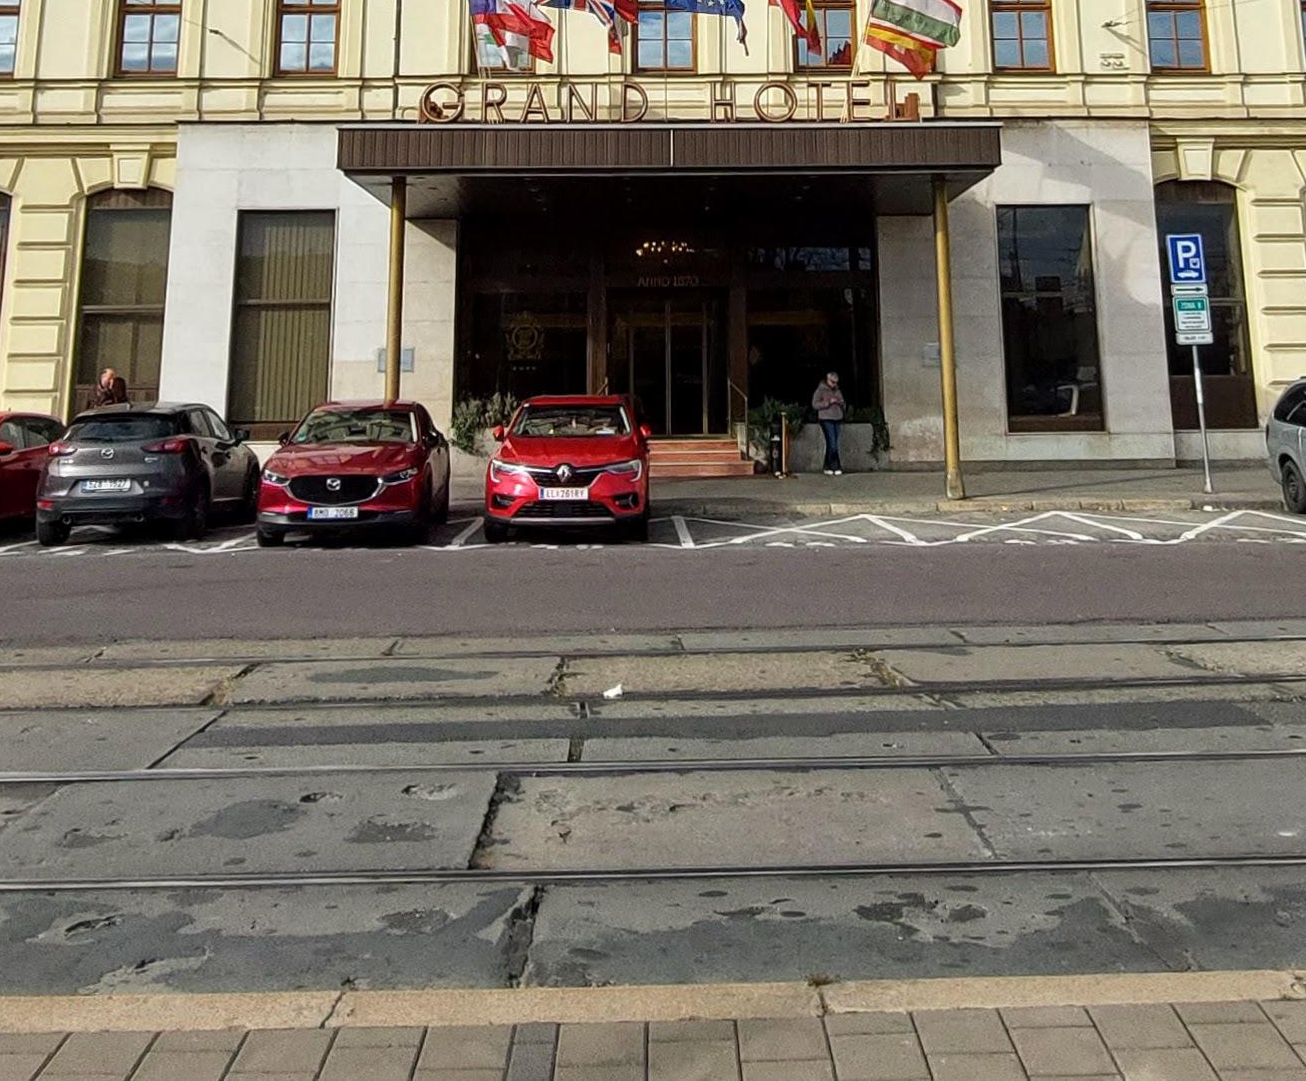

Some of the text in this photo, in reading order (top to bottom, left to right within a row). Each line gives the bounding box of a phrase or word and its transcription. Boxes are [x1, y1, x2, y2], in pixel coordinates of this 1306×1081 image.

[421, 80, 920, 124] GRAND HOTEL
[1176, 240, 1197, 269] P
[637, 275, 671, 288] ANNO
